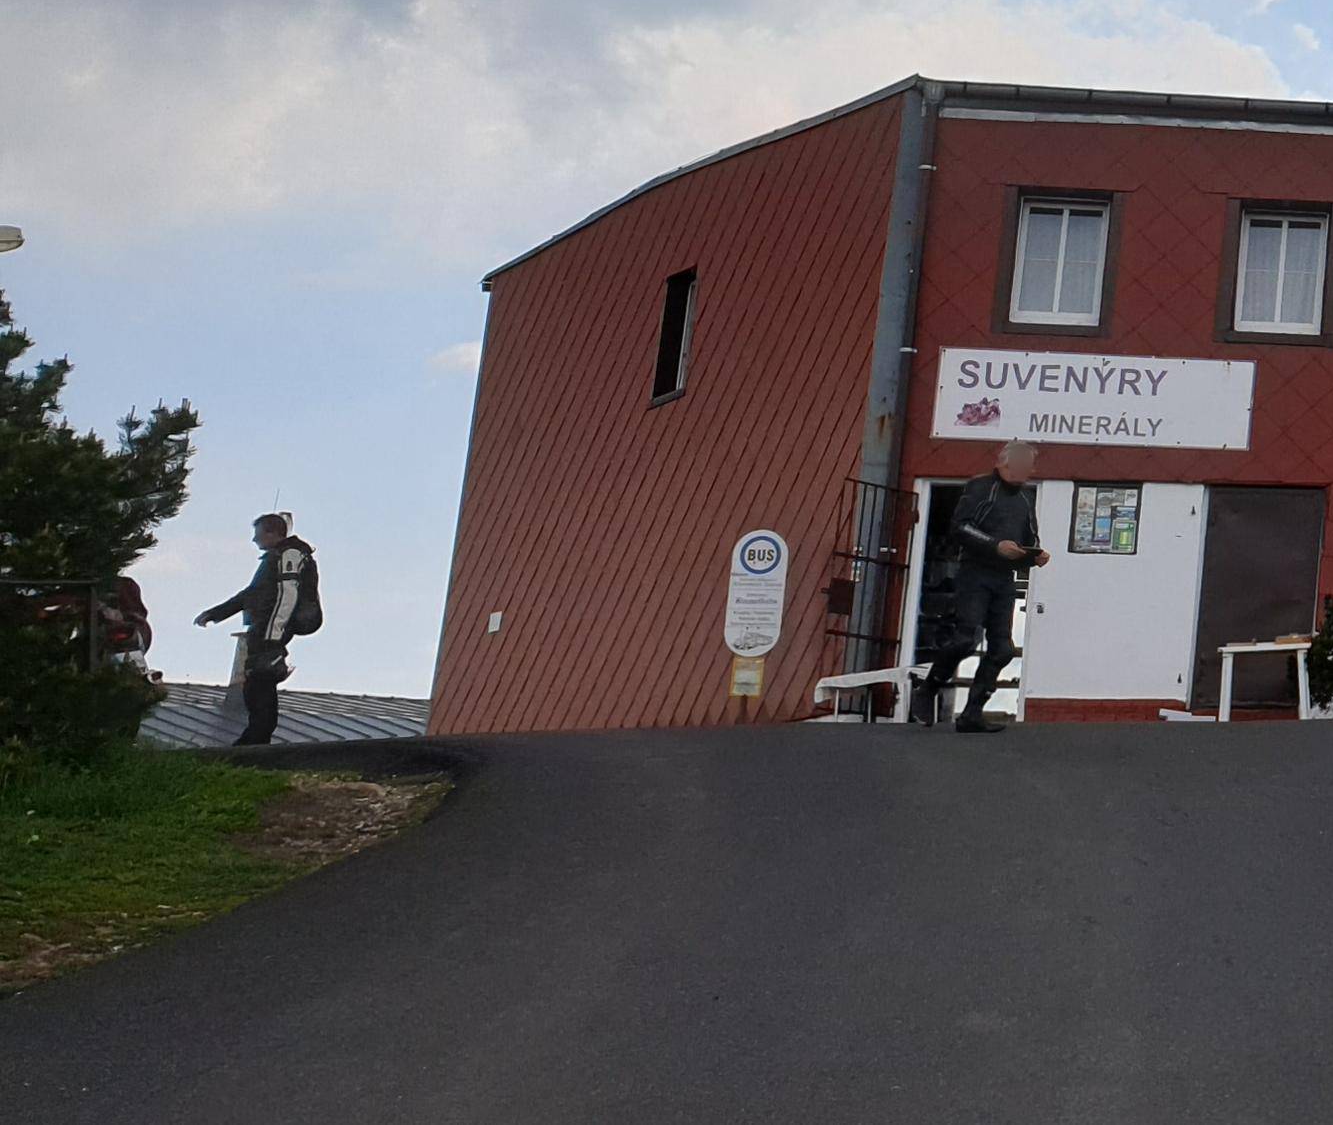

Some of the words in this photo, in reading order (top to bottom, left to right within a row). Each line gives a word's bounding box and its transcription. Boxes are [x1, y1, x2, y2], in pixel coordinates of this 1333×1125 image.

[957, 358, 1168, 396] SUVENÝRY
[1029, 412, 1163, 437] MINERÁLY
[747, 549, 775, 562] BUS
